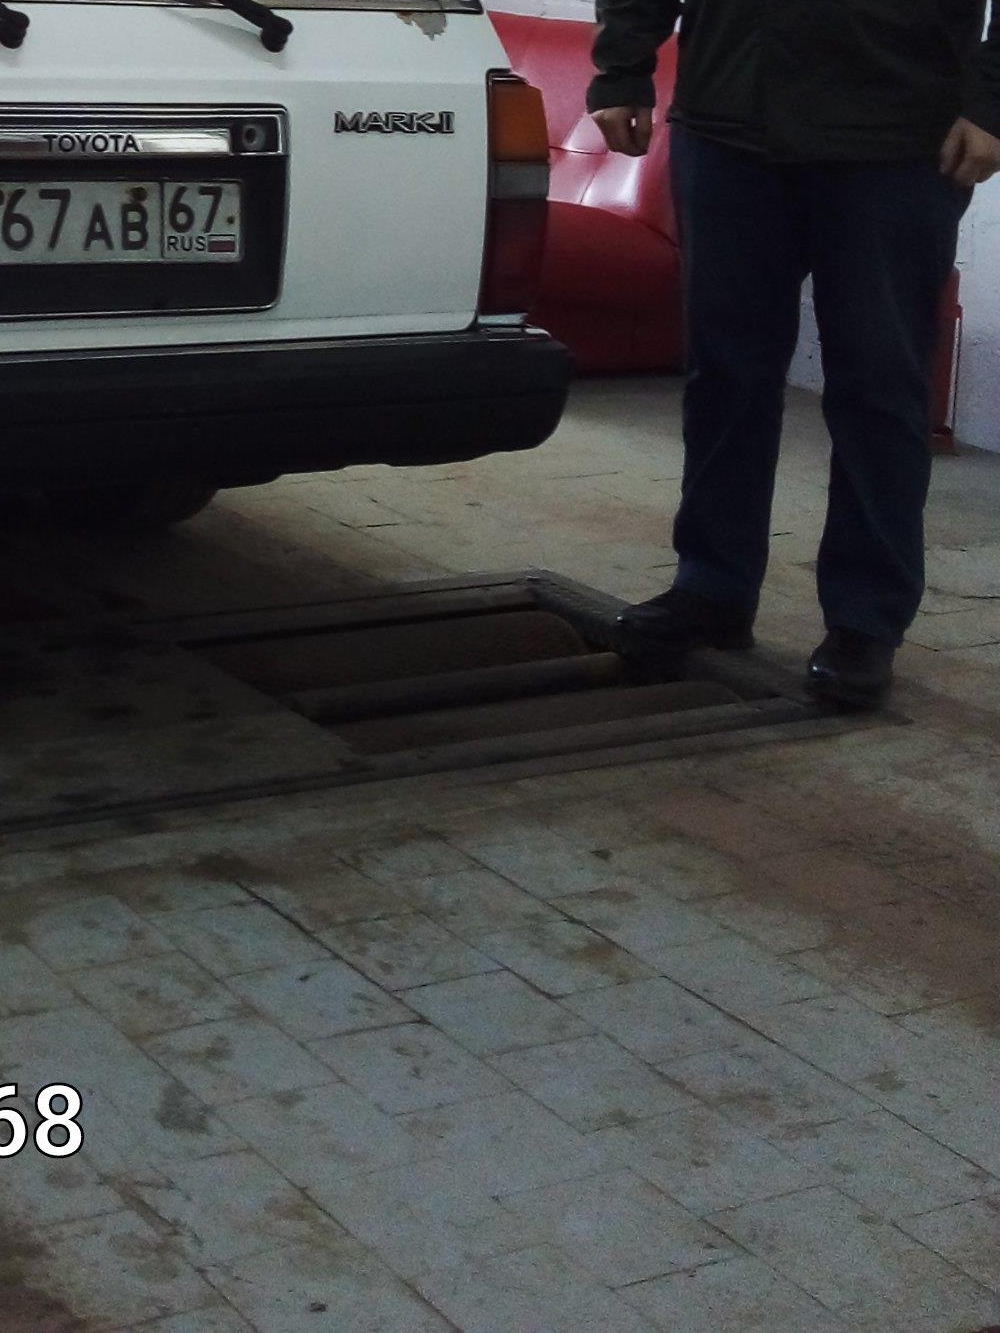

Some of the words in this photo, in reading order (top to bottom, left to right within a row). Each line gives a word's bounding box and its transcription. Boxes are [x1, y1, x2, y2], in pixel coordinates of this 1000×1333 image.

[42, 133, 141, 153] TOYOTA
[168, 185, 222, 234] 67
[167, 235, 206, 252] RUS
